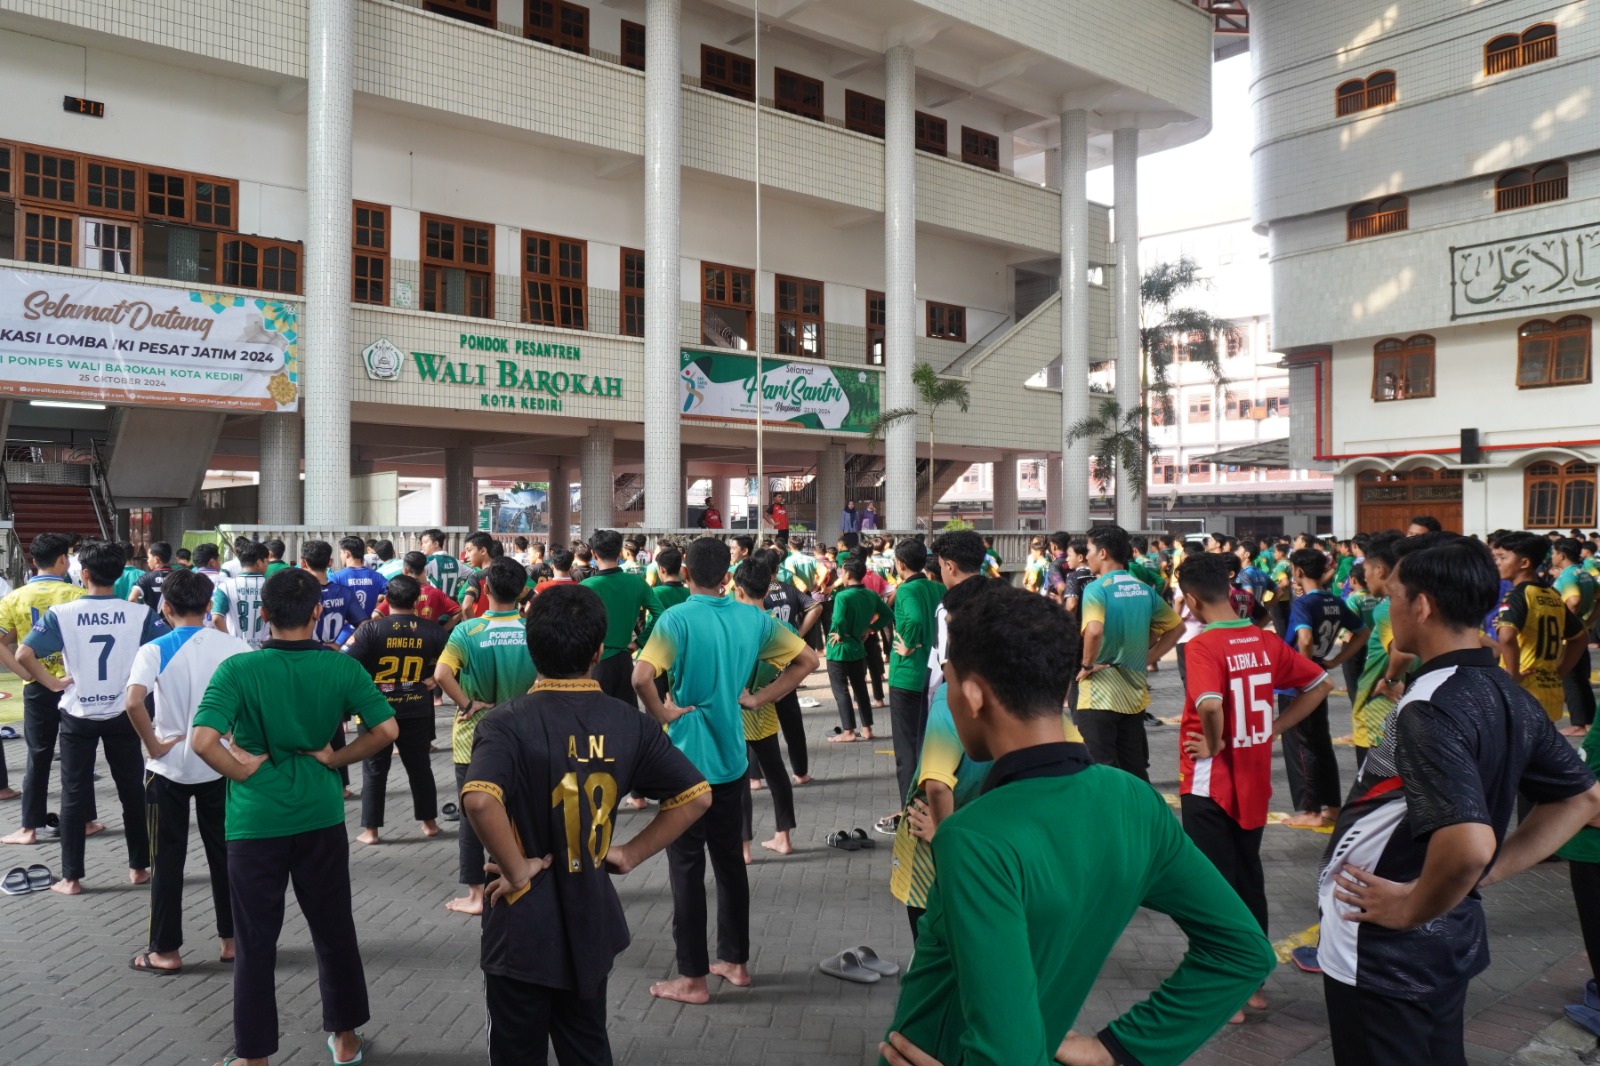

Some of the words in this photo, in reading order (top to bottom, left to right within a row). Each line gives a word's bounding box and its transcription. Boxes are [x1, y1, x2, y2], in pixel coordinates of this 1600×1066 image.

[23, 290, 131, 325] Selamat
[130, 301, 215, 341] Datang
[46, 333, 108, 350] LOMBA
[139, 341, 190, 357] PESAT
[191, 346, 237, 361] JATIM
[240, 351, 275, 363] 2024
[460, 333, 508, 353] PONDOK
[515, 340, 581, 361] PESANTREN
[8, 355, 63, 368] PONPES
[67, 360, 100, 371] WALI
[105, 363, 166, 376] BAROKAH
[170, 369, 202, 379] KOTA
[205, 371, 243, 382] KEDIRI
[410, 352, 486, 386] WALI
[496, 360, 623, 398] BAROKAH
[786, 364, 814, 375] Selamat
[144, 379, 167, 387] 2024
[743, 374, 791, 404] Hari
[791, 375, 842, 406] Santri
[481, 394, 516, 408] KOTA
[521, 397, 563, 412] KEDIRI
[441, 572, 458, 597] 17
[77, 612, 126, 626] MAS.M
[89, 634, 116, 681] 7
[374, 656, 424, 684] 20
[1230, 672, 1272, 748] 15
[552, 772, 618, 873] 18
